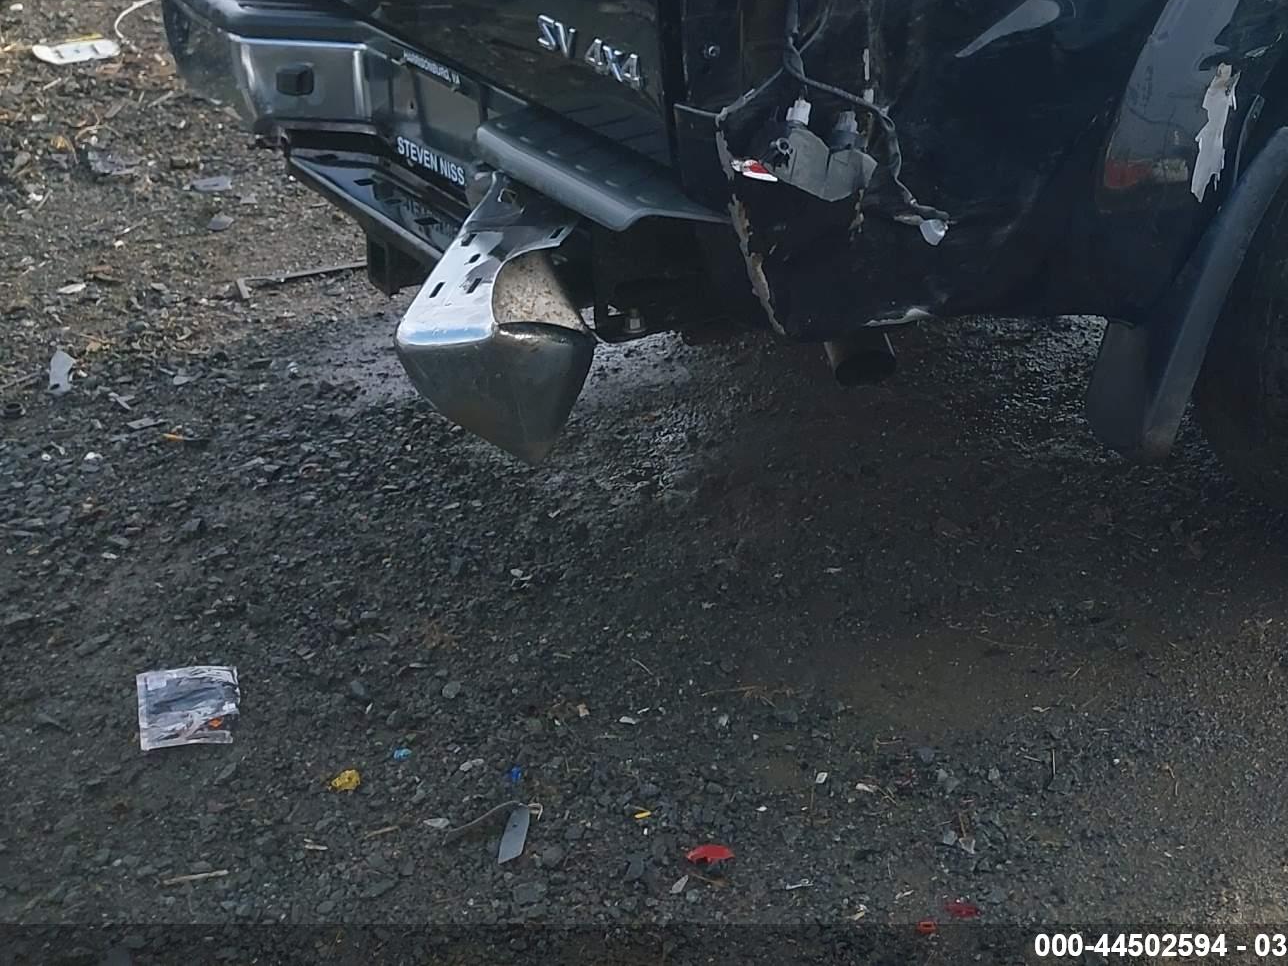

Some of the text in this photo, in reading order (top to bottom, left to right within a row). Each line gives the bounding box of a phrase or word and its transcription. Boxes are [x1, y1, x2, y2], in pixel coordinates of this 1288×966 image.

[538, 14, 576, 58] SV
[397, 136, 465, 186] STEVEN NISS
